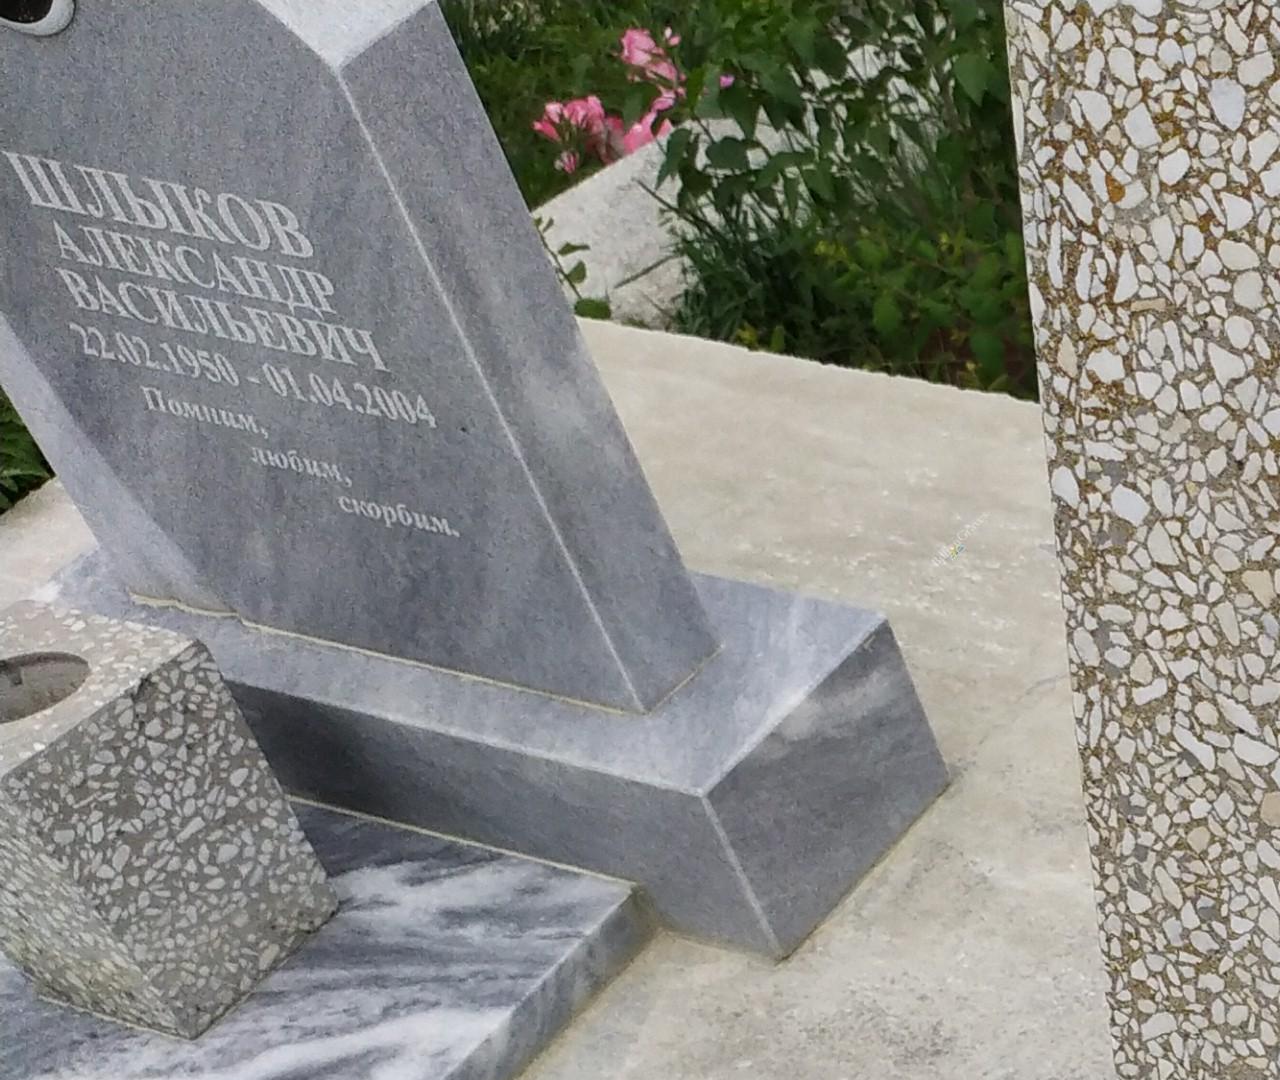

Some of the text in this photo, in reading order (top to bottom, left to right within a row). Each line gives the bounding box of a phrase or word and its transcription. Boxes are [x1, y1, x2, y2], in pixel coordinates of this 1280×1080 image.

[2, 151, 315, 259] ШЛЫКОВ
[52, 220, 338, 319] АЛЕКСАНДР
[55, 268, 391, 373] ВАСИЛЬЕВИЧ
[69, 322, 240, 387] 22.02.1950
[261, 362, 437, 429] 01.04.2004
[140, 385, 269, 439] Помним,
[252, 445, 353, 487] любим,
[338, 495, 461, 538] скорбим.
